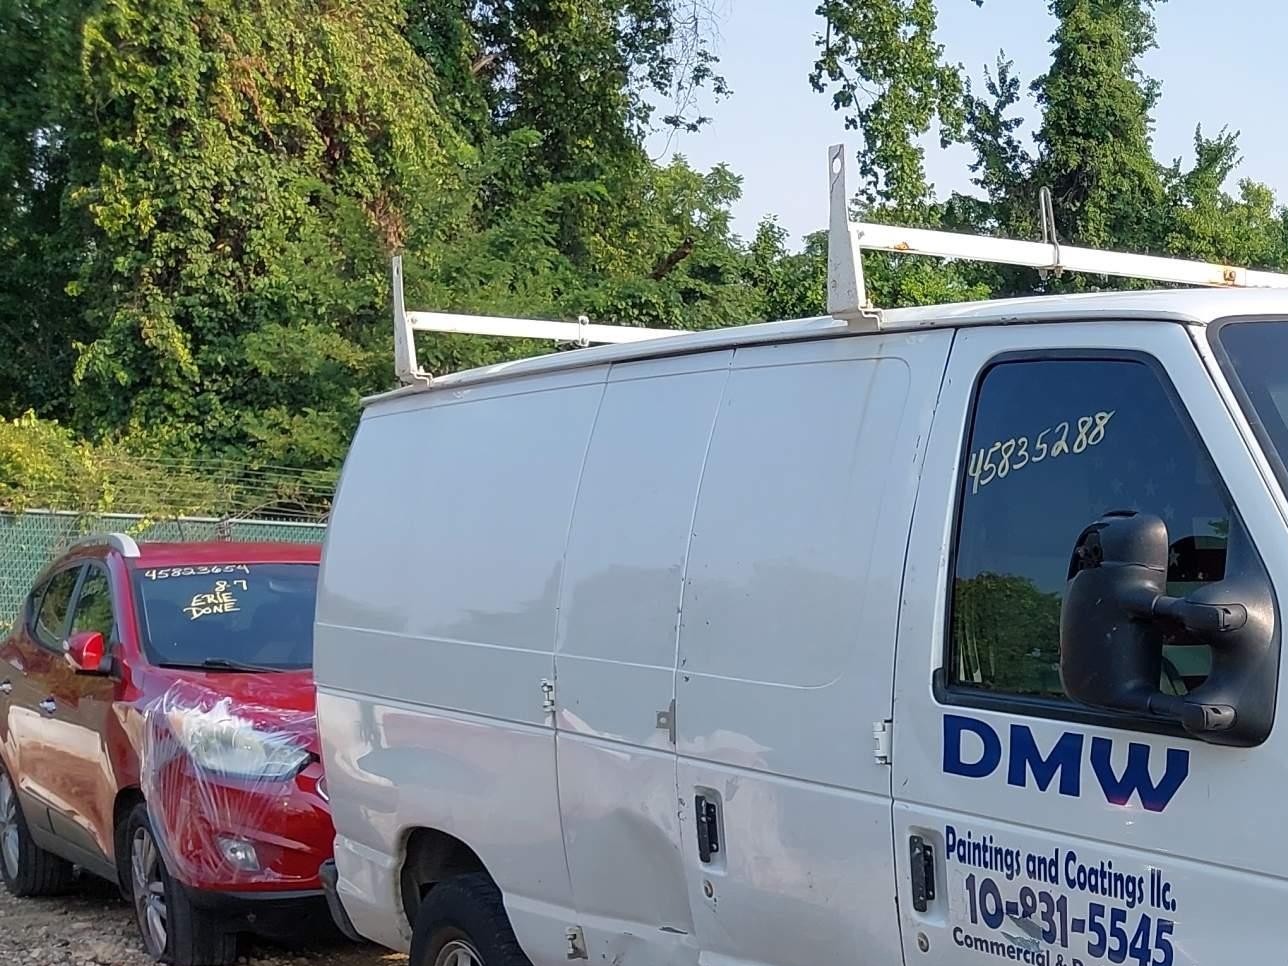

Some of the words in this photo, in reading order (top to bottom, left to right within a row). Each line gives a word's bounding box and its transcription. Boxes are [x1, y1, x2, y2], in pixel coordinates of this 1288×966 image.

[968, 410, 1116, 494] 45835288
[183, 602, 241, 620] DONE
[943, 713, 1190, 813] DMW
[945, 825, 1021, 880] Paintings
[1026, 848, 1060, 886] and
[1064, 850, 1145, 909] Coatings
